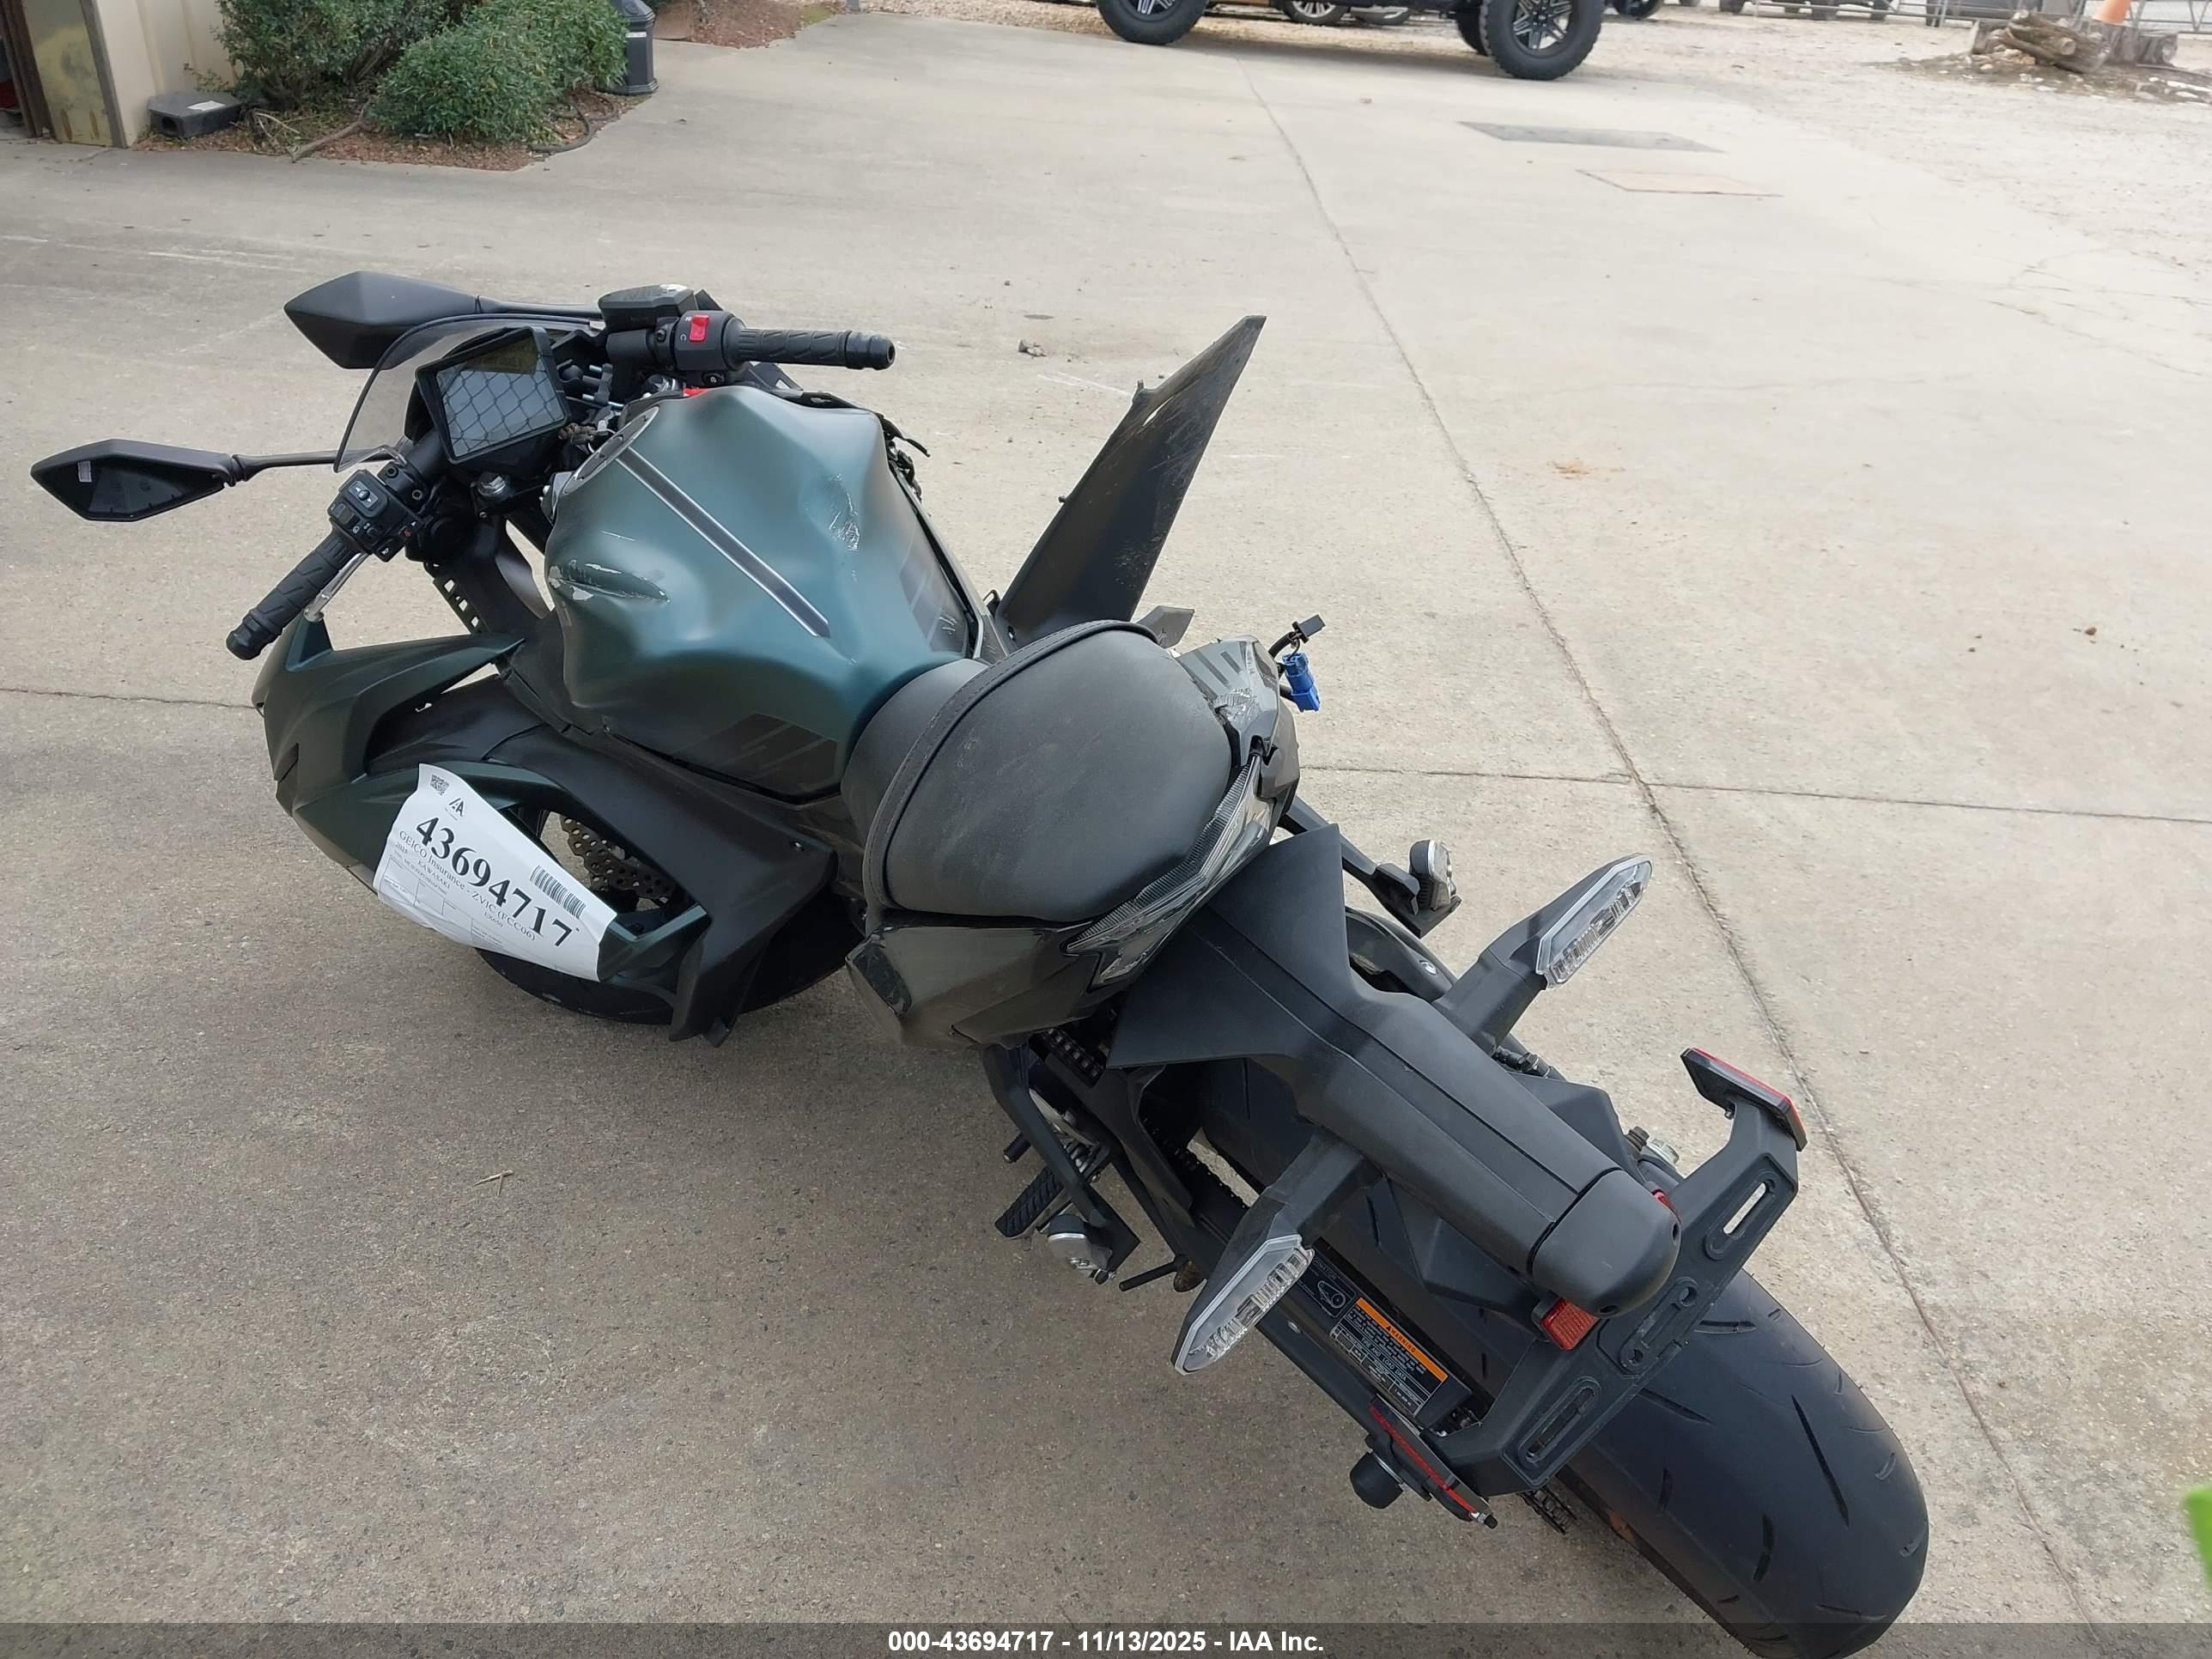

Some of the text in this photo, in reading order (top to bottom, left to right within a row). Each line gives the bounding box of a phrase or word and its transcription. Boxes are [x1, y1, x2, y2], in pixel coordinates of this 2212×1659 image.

[399, 830, 428, 858] GEICO
[428, 854, 465, 890] Insurance
[417, 860, 451, 889] KAWASAKI
[1391, 1329, 1416, 1352] WARNING
[1371, 1348, 1381, 1357] AND
[1382, 1358, 1395, 1370] LOAD
[1395, 1370, 1407, 1381] DATA
